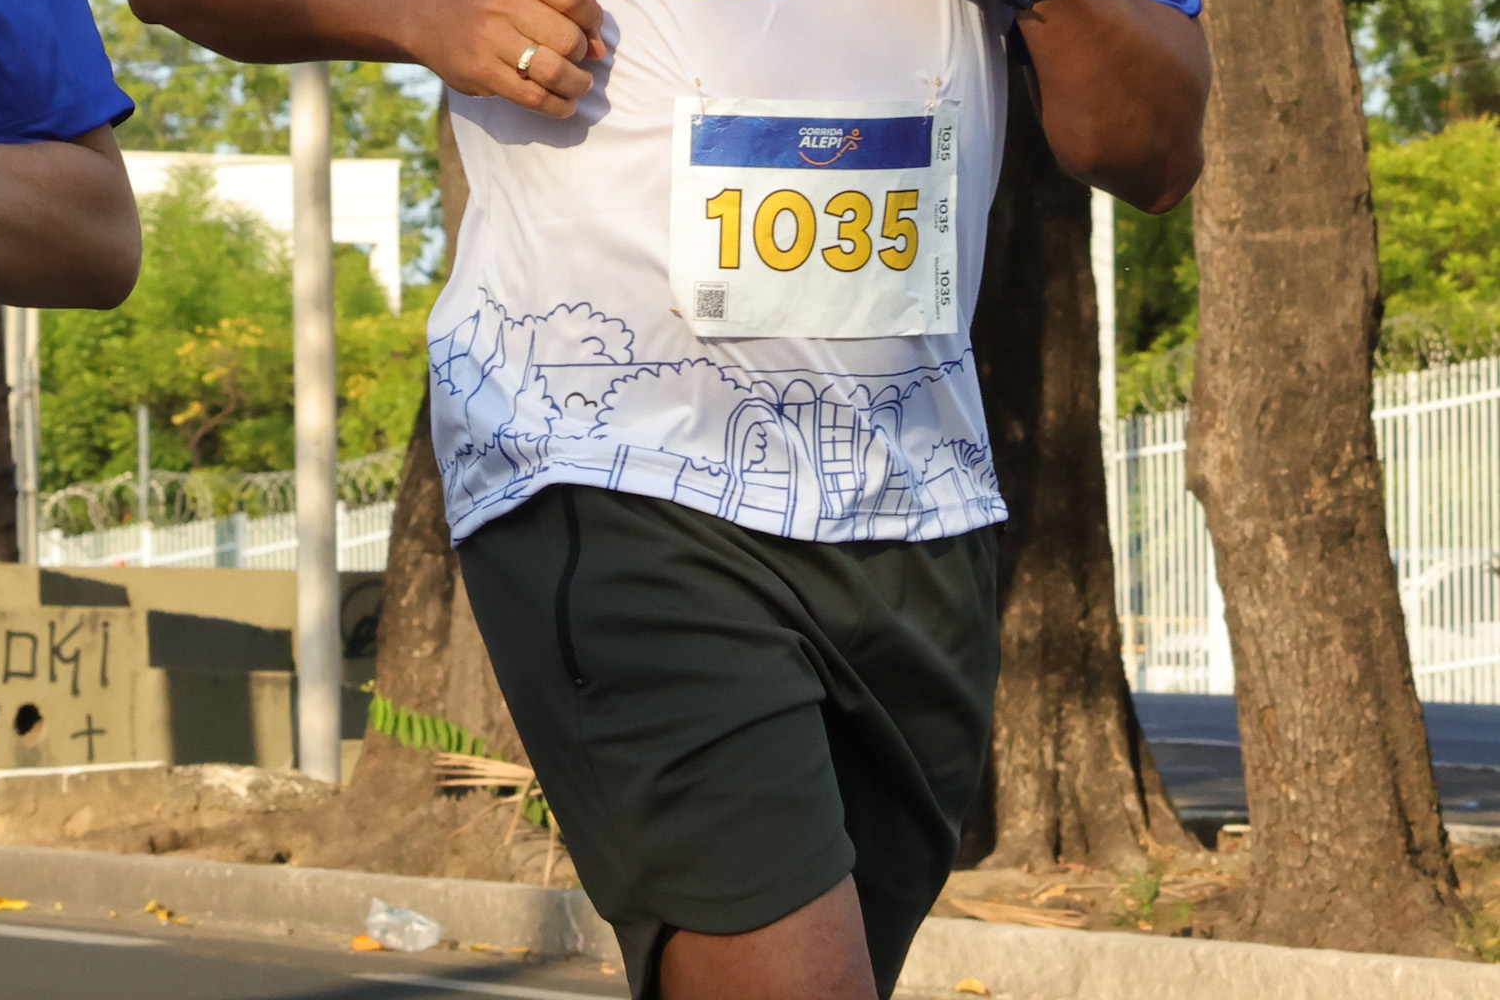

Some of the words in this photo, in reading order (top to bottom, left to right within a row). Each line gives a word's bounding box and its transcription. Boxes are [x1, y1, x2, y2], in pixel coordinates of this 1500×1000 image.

[798, 127, 844, 136] CORRIDA
[798, 136, 843, 149] ALEPI
[941, 125, 953, 161] 1035
[706, 188, 919, 272] 1035
[938, 197, 949, 233] 1035
[940, 270, 950, 306] 1035
